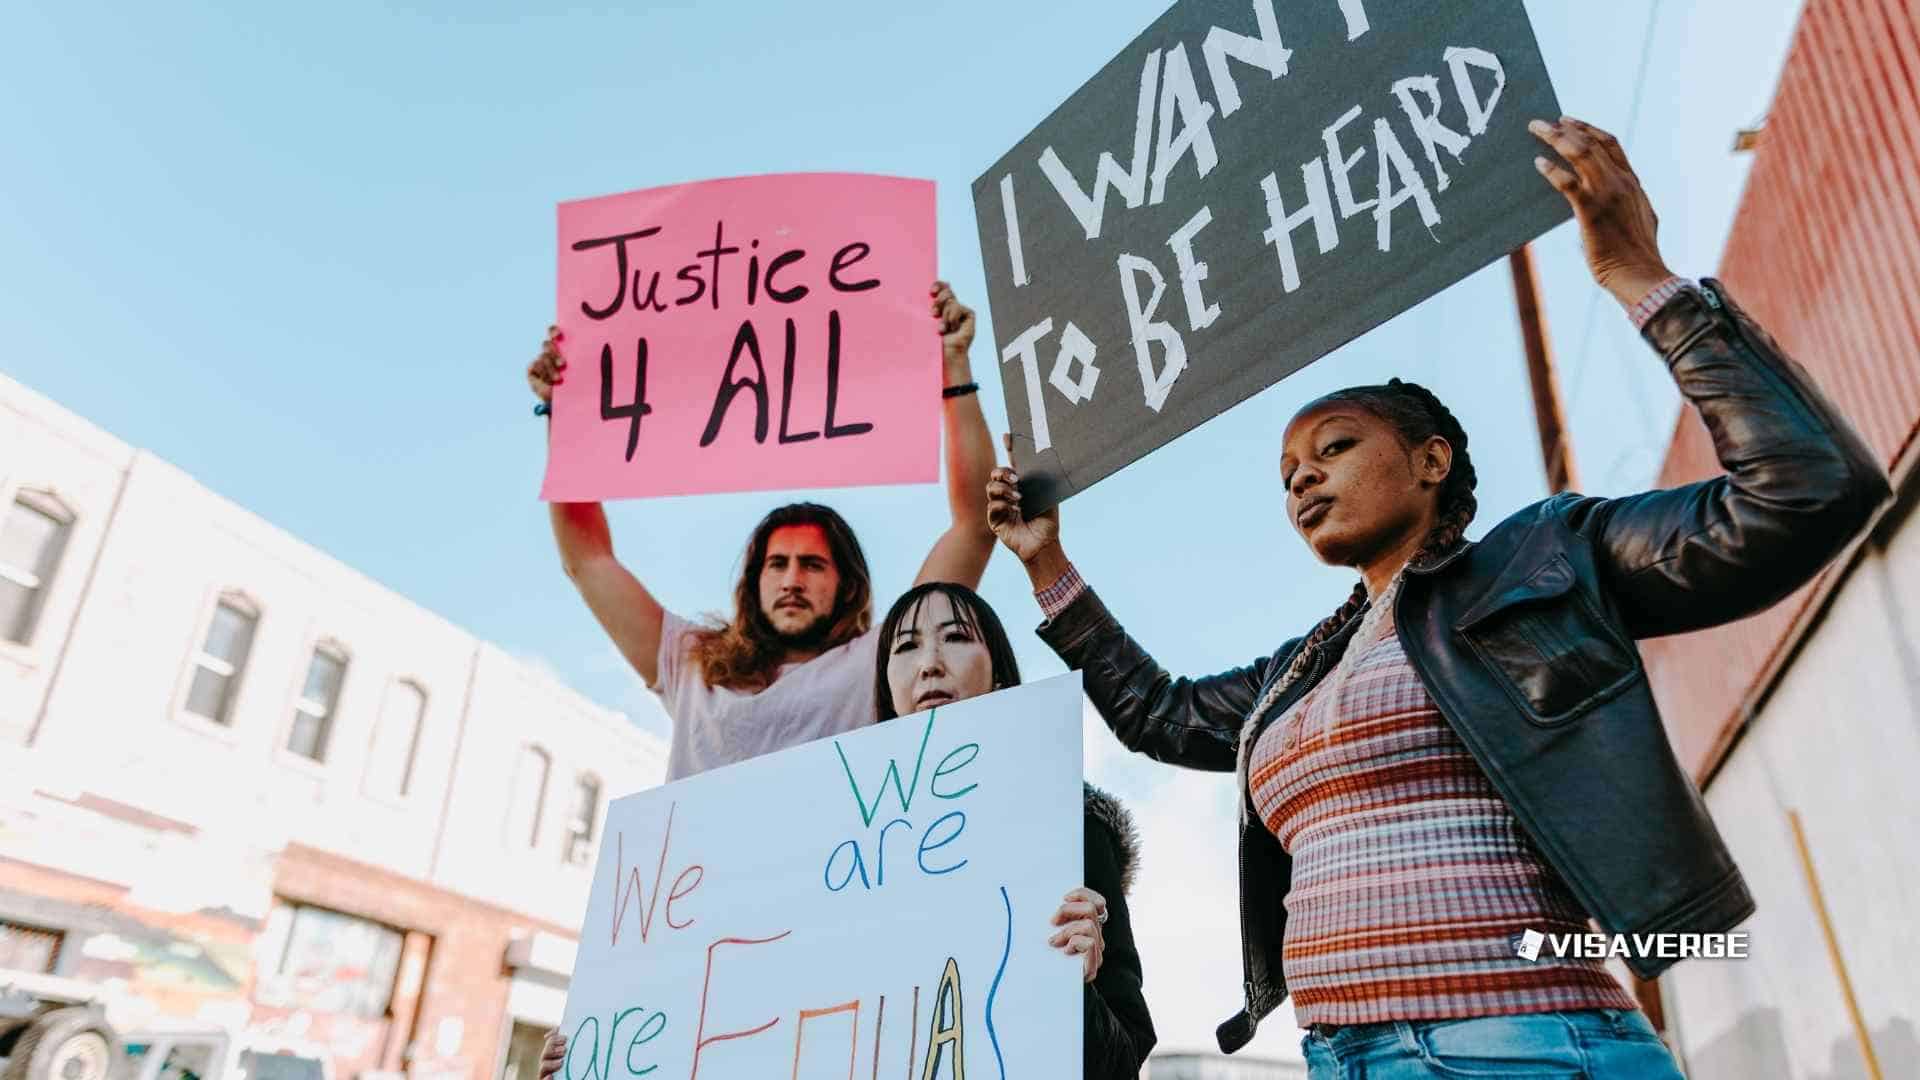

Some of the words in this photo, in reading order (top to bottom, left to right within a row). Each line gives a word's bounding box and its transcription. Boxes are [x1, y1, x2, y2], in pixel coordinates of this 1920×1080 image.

[572, 221, 880, 320] Justice
[1000, 173, 1031, 288] I
[1117, 205, 1221, 413] BE
[1263, 45, 1505, 293] HEARD
[600, 337, 652, 462] 4
[700, 309, 874, 447] ALL
[835, 707, 979, 827] We
[611, 801, 704, 946] We
[825, 811, 968, 891] are
[565, 1006, 666, 1080] are
